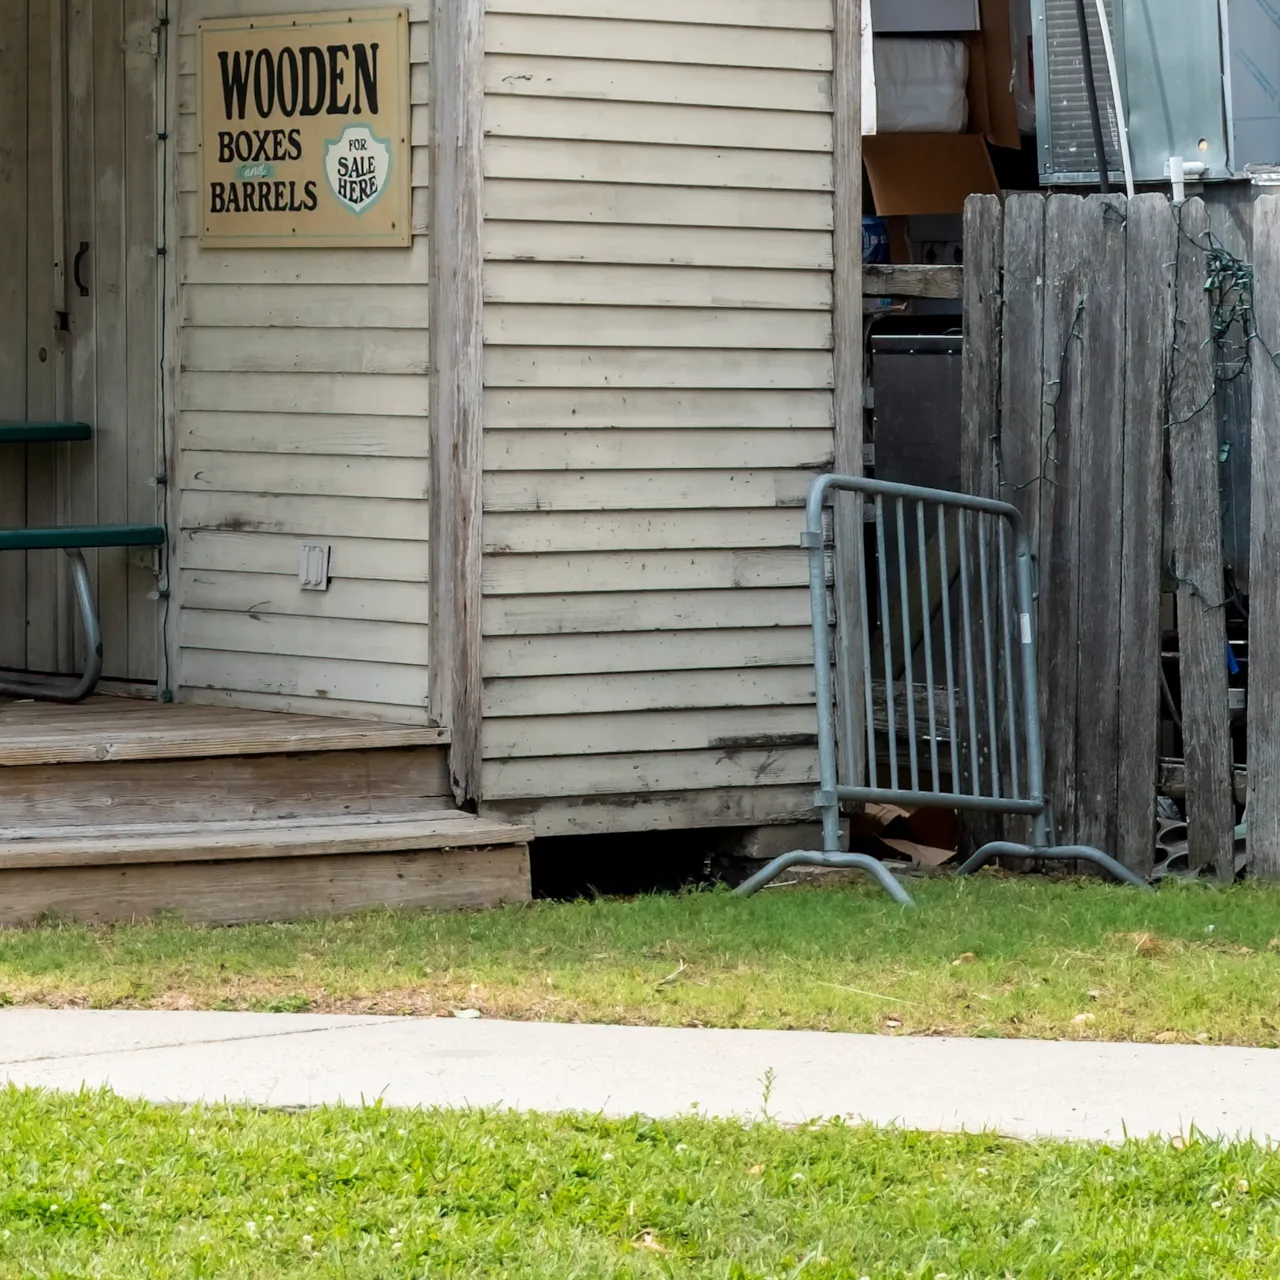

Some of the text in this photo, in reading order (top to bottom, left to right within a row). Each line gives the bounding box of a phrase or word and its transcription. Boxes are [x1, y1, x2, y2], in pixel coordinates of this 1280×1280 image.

[217, 42, 379, 120] WOODEN
[218, 128, 302, 163] BOXES
[348, 138, 368, 152] FOR
[243, 164, 268, 179] and
[337, 156, 375, 178] SALE
[210, 180, 317, 213] BARRELS
[337, 177, 378, 204] HERE
